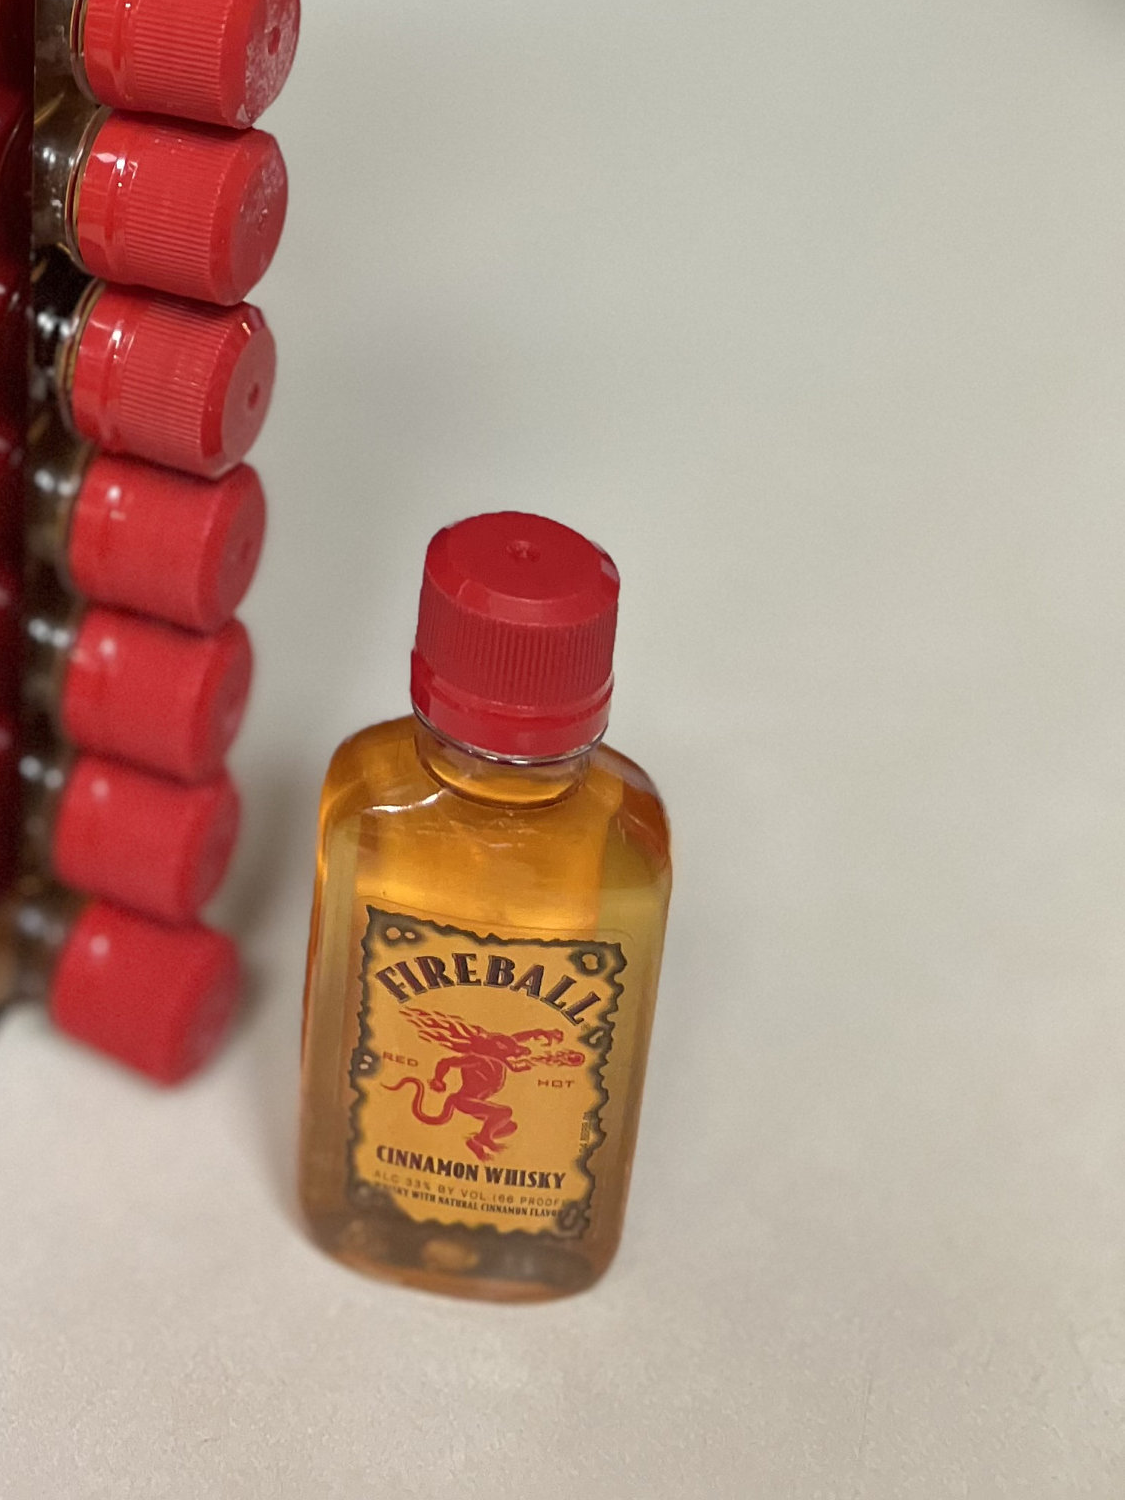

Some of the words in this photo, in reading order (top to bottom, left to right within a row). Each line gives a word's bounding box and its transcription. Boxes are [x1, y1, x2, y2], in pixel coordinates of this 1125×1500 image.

[375, 952, 602, 1027] FIREBALL
[383, 1051, 419, 1068] RED
[537, 1079, 575, 1089] HOT
[376, 1145, 480, 1183] CINNAMON
[484, 1166, 567, 1190] WHISKY
[437, 1184, 455, 1196] BY
[411, 1190, 436, 1203] WITH
[437, 1195, 479, 1212] NATURAL
[481, 1202, 528, 1217] CINNAMON
